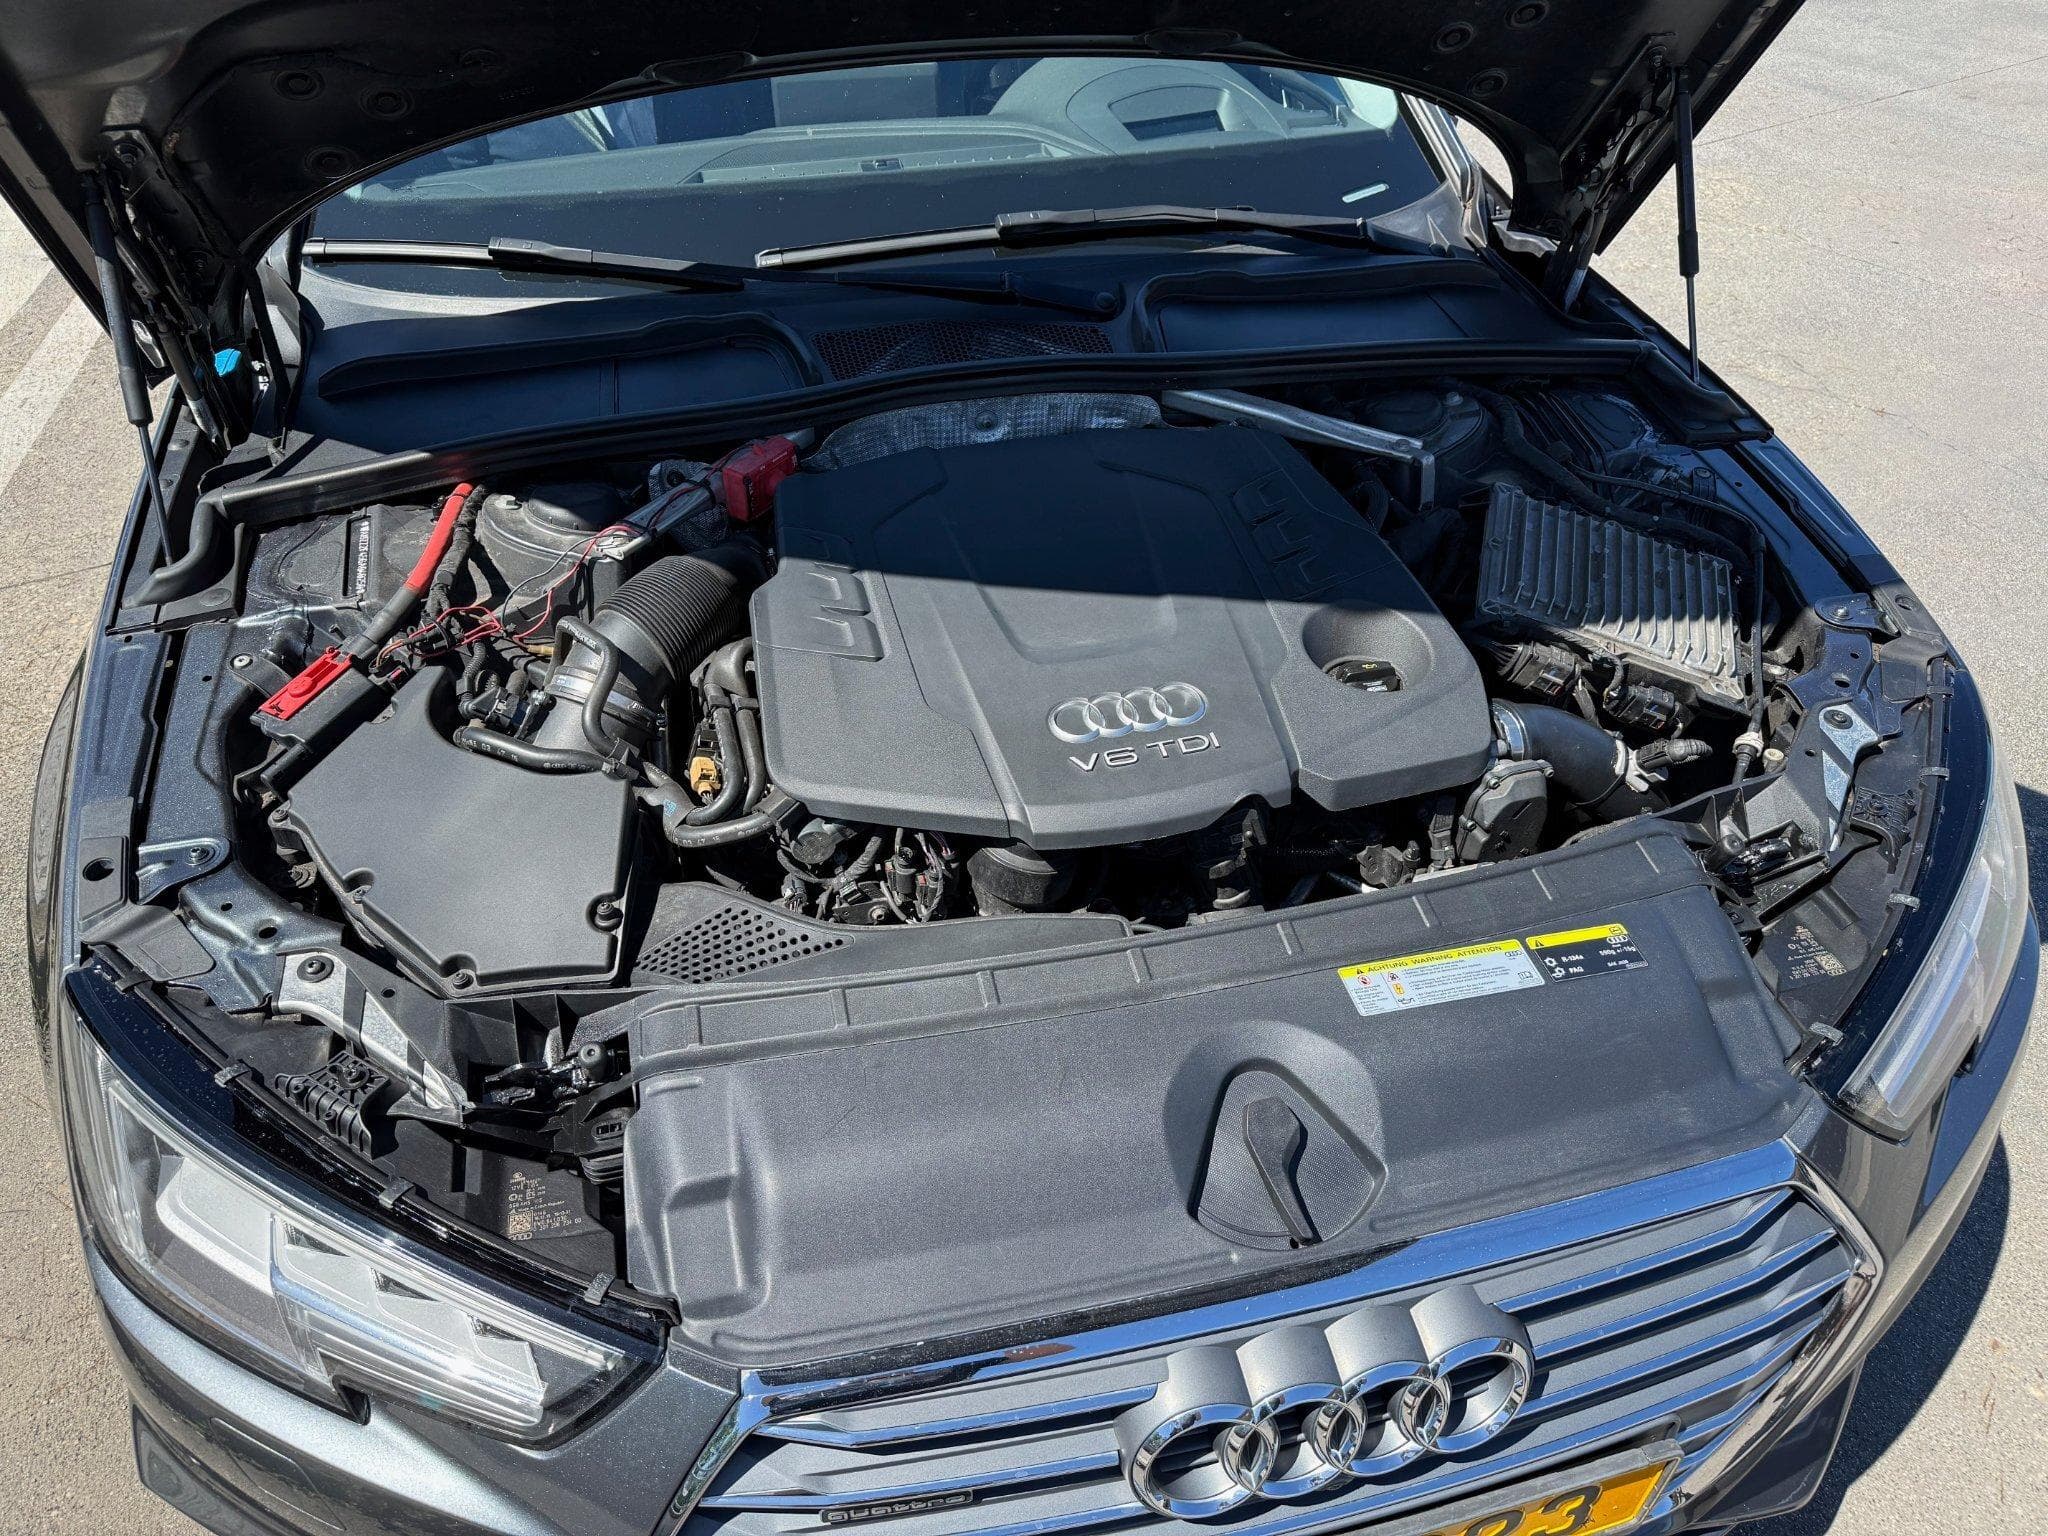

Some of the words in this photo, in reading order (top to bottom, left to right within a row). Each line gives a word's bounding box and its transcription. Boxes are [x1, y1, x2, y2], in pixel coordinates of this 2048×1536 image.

[1068, 746, 1139, 773] V6
[1145, 731, 1221, 759] TDI
[1367, 959, 1408, 973] ACHTUNG
[1412, 952, 1454, 967] WARNING
[1458, 945, 1502, 959] ATTENTION
[827, 1495, 965, 1521] quattro
